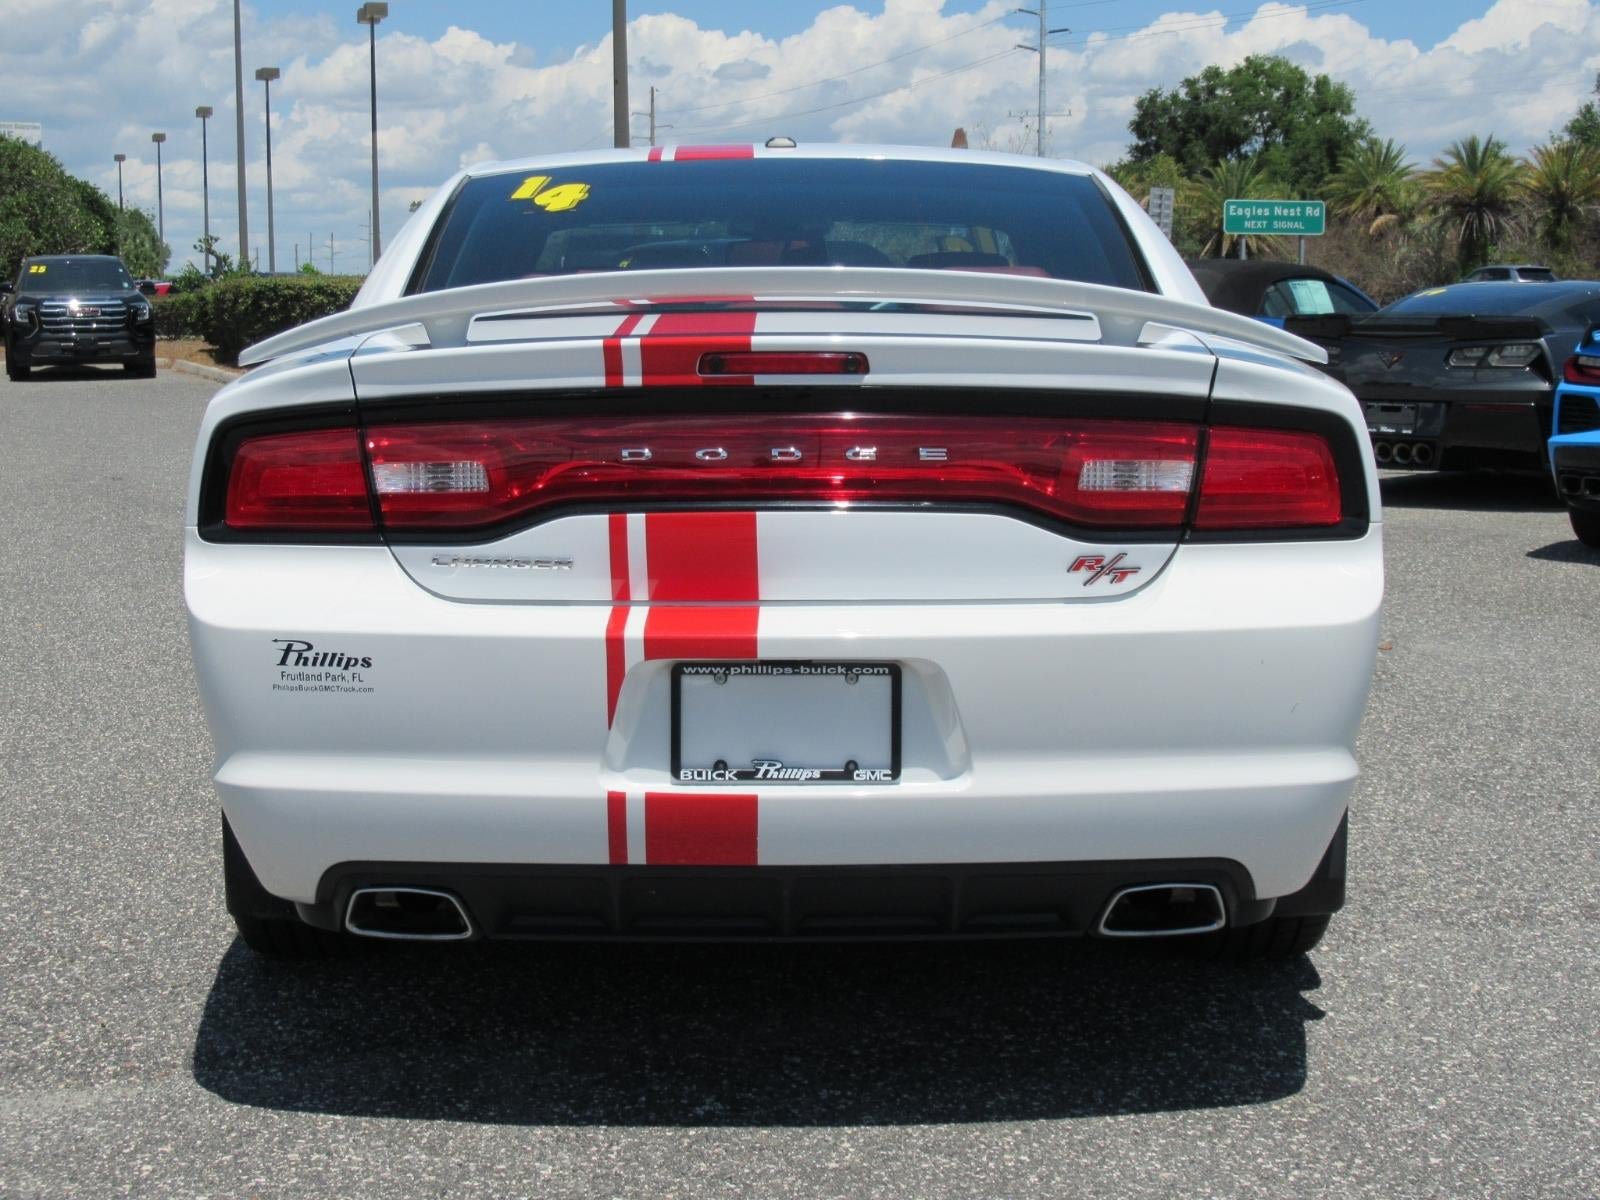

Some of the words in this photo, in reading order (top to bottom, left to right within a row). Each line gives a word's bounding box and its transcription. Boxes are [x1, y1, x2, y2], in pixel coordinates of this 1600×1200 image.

[511, 176, 590, 212] 14
[1229, 206, 1270, 218] Eagles
[1274, 206, 1302, 216] Nest
[1305, 206, 1320, 217] Rd
[1244, 221, 1268, 229] NEXT
[1272, 221, 1305, 230] SIGNAL
[621, 447, 948, 461] DODGE
[431, 554, 574, 570] CHARGER
[1066, 553, 1142, 587] R/T
[271, 638, 373, 671] Phillips
[280, 671, 323, 682] Fruitland
[324, 672, 350, 684] Park,
[352, 672, 365, 683] FL
[683, 665, 890, 676] www.phillips-buick.com
[680, 769, 739, 781] BUICK
[751, 759, 822, 781] Phillips
[852, 769, 893, 781] GMC
